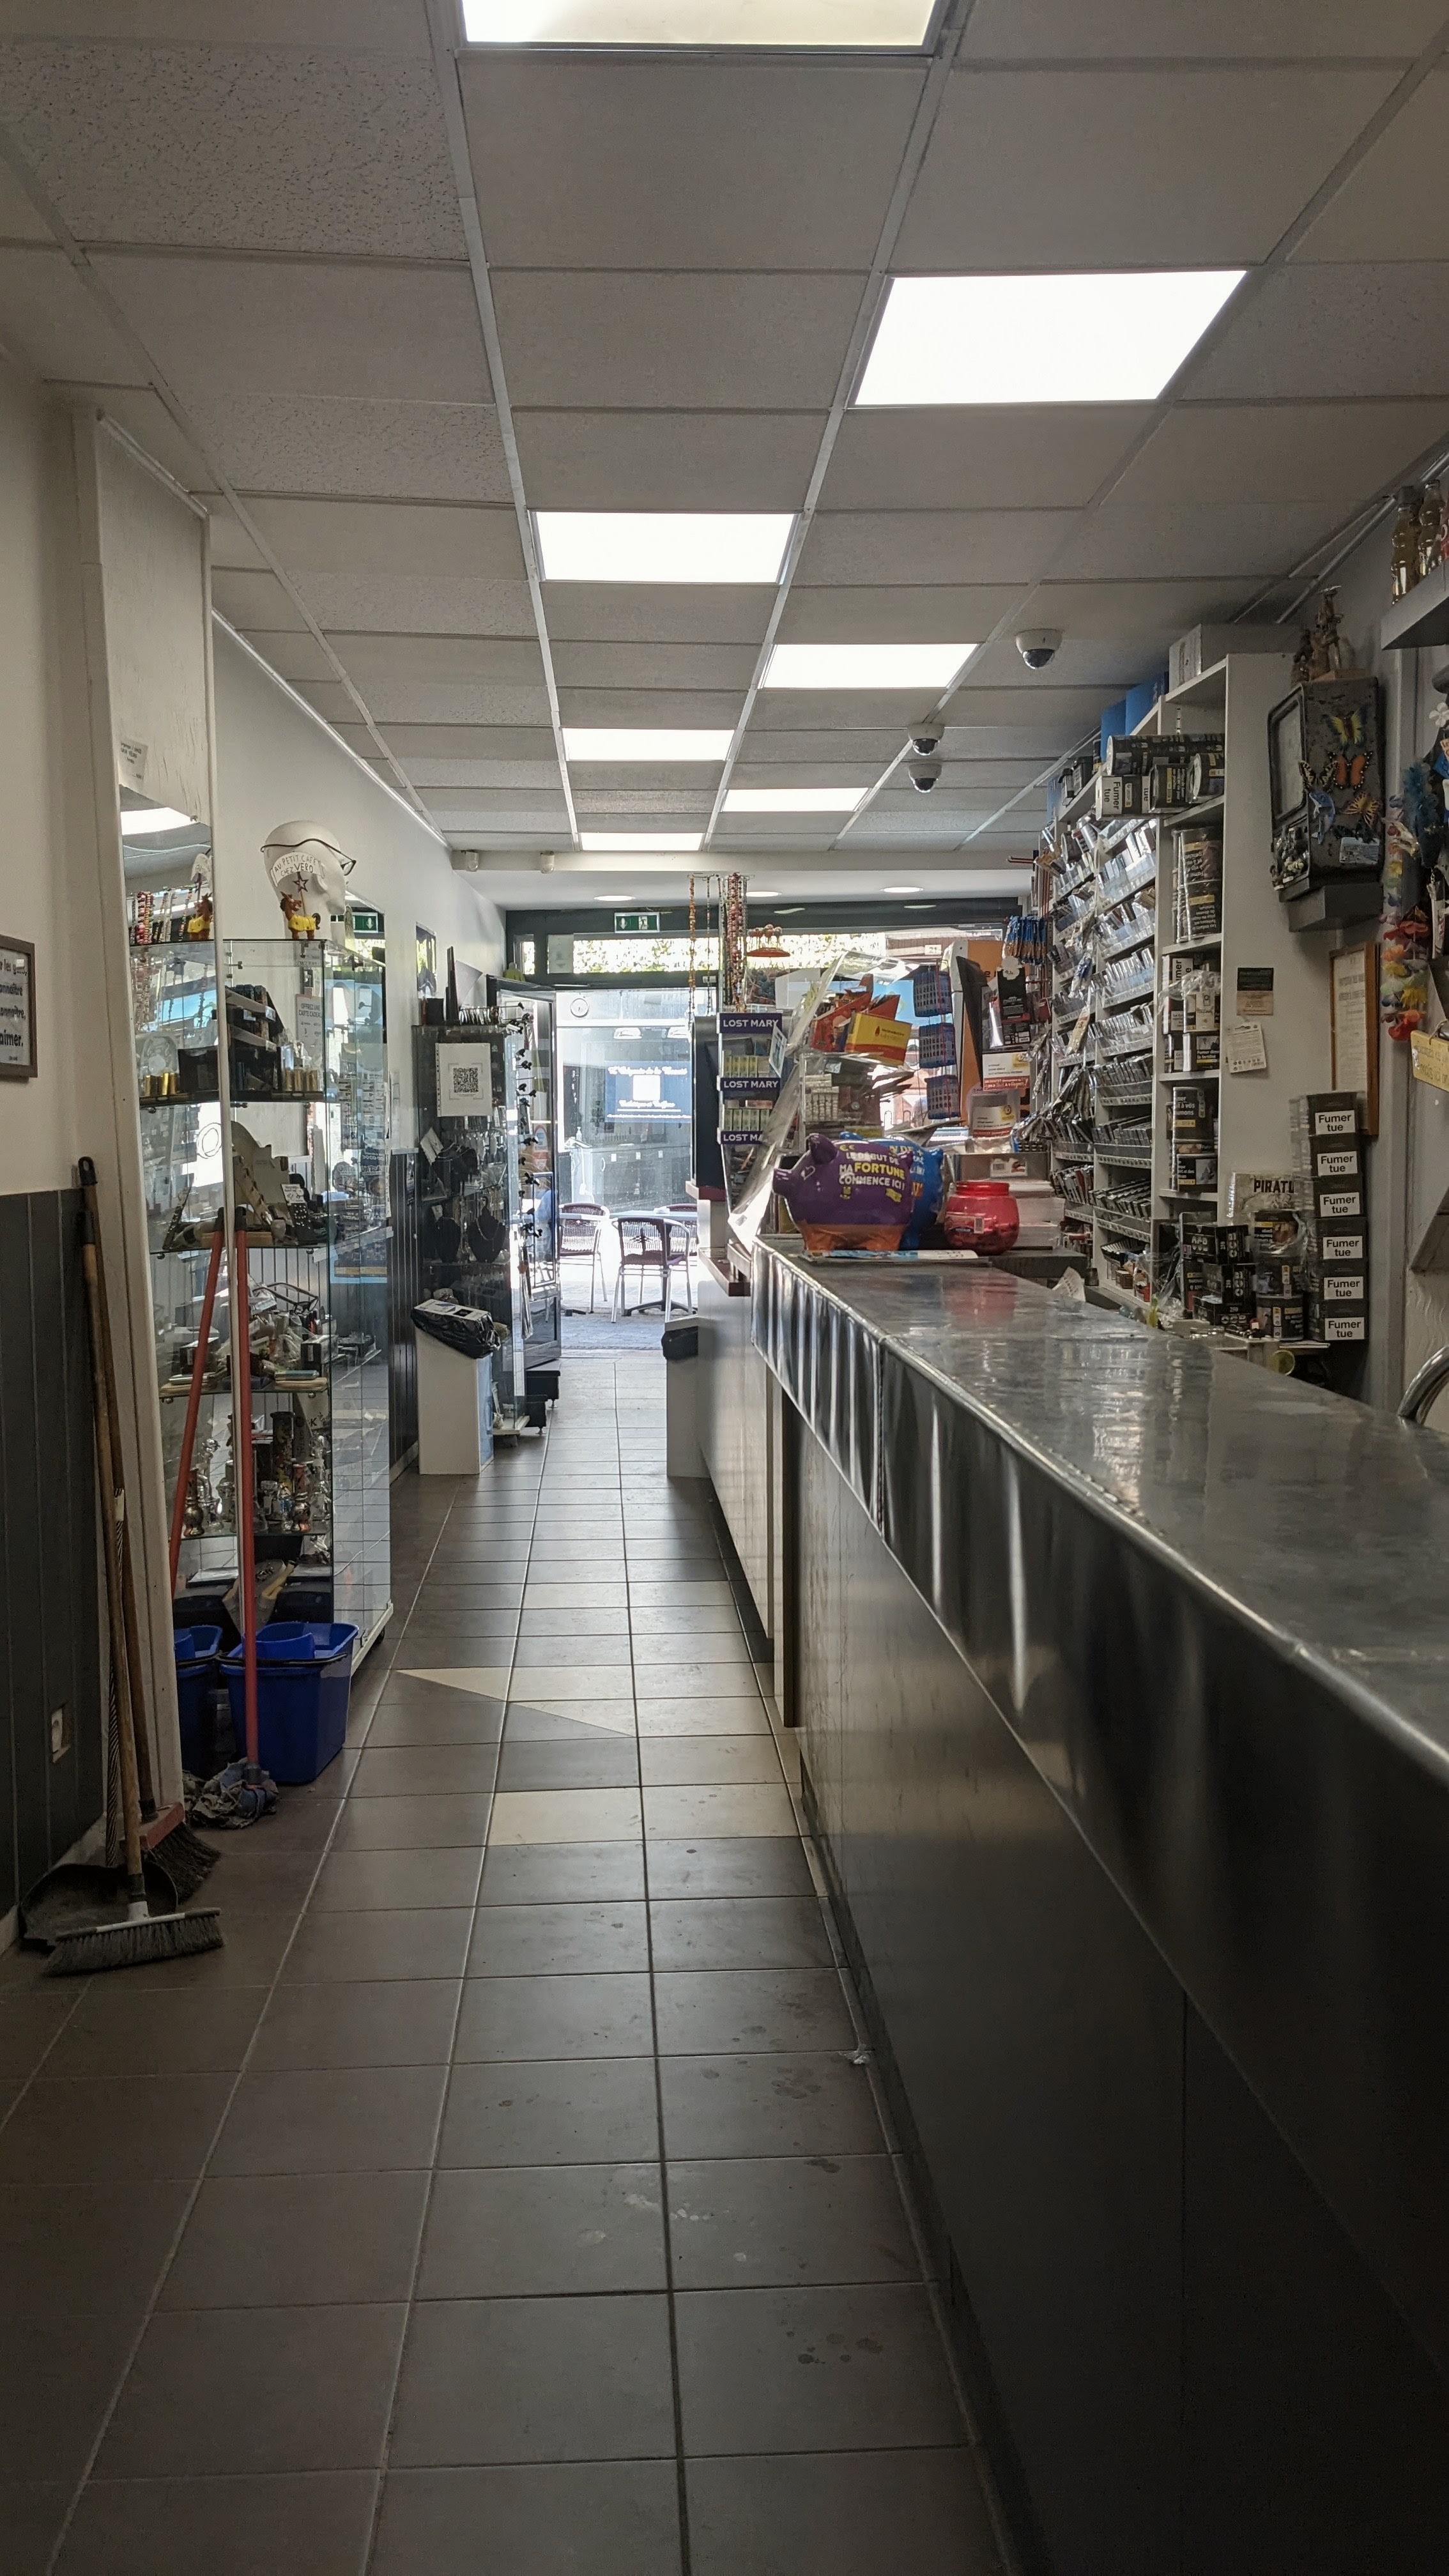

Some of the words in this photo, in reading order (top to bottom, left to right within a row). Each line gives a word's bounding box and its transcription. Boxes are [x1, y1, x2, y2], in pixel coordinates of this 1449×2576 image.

[274, 863, 282, 873] AU
[282, 855, 299, 865] PETIT
[281, 866, 294, 876] CHEZ
[723, 1019, 749, 1027] LOST
[750, 1019, 779, 1027] MARY
[723, 1080, 749, 1089] LOST
[1319, 1114, 1352, 1124] Fumer
[750, 1133, 763, 1142] MA
[1321, 1155, 1354, 1165] Fumer
[839, 1164, 854, 1174] MA
[854, 1162, 905, 1181] FORTUNE
[839, 1175, 891, 1186] COMMENCE
[1323, 1196, 1356, 1206] Fumer
[1332, 1206, 1348, 1214] tue
[1326, 1239, 1359, 1248] Fumer
[1335, 1248, 1351, 1257] tue
[1327, 1279, 1360, 1288] Fumer
[1328, 1320, 1361, 1329] Fumer
[1337, 1330, 1353, 1338] tue
